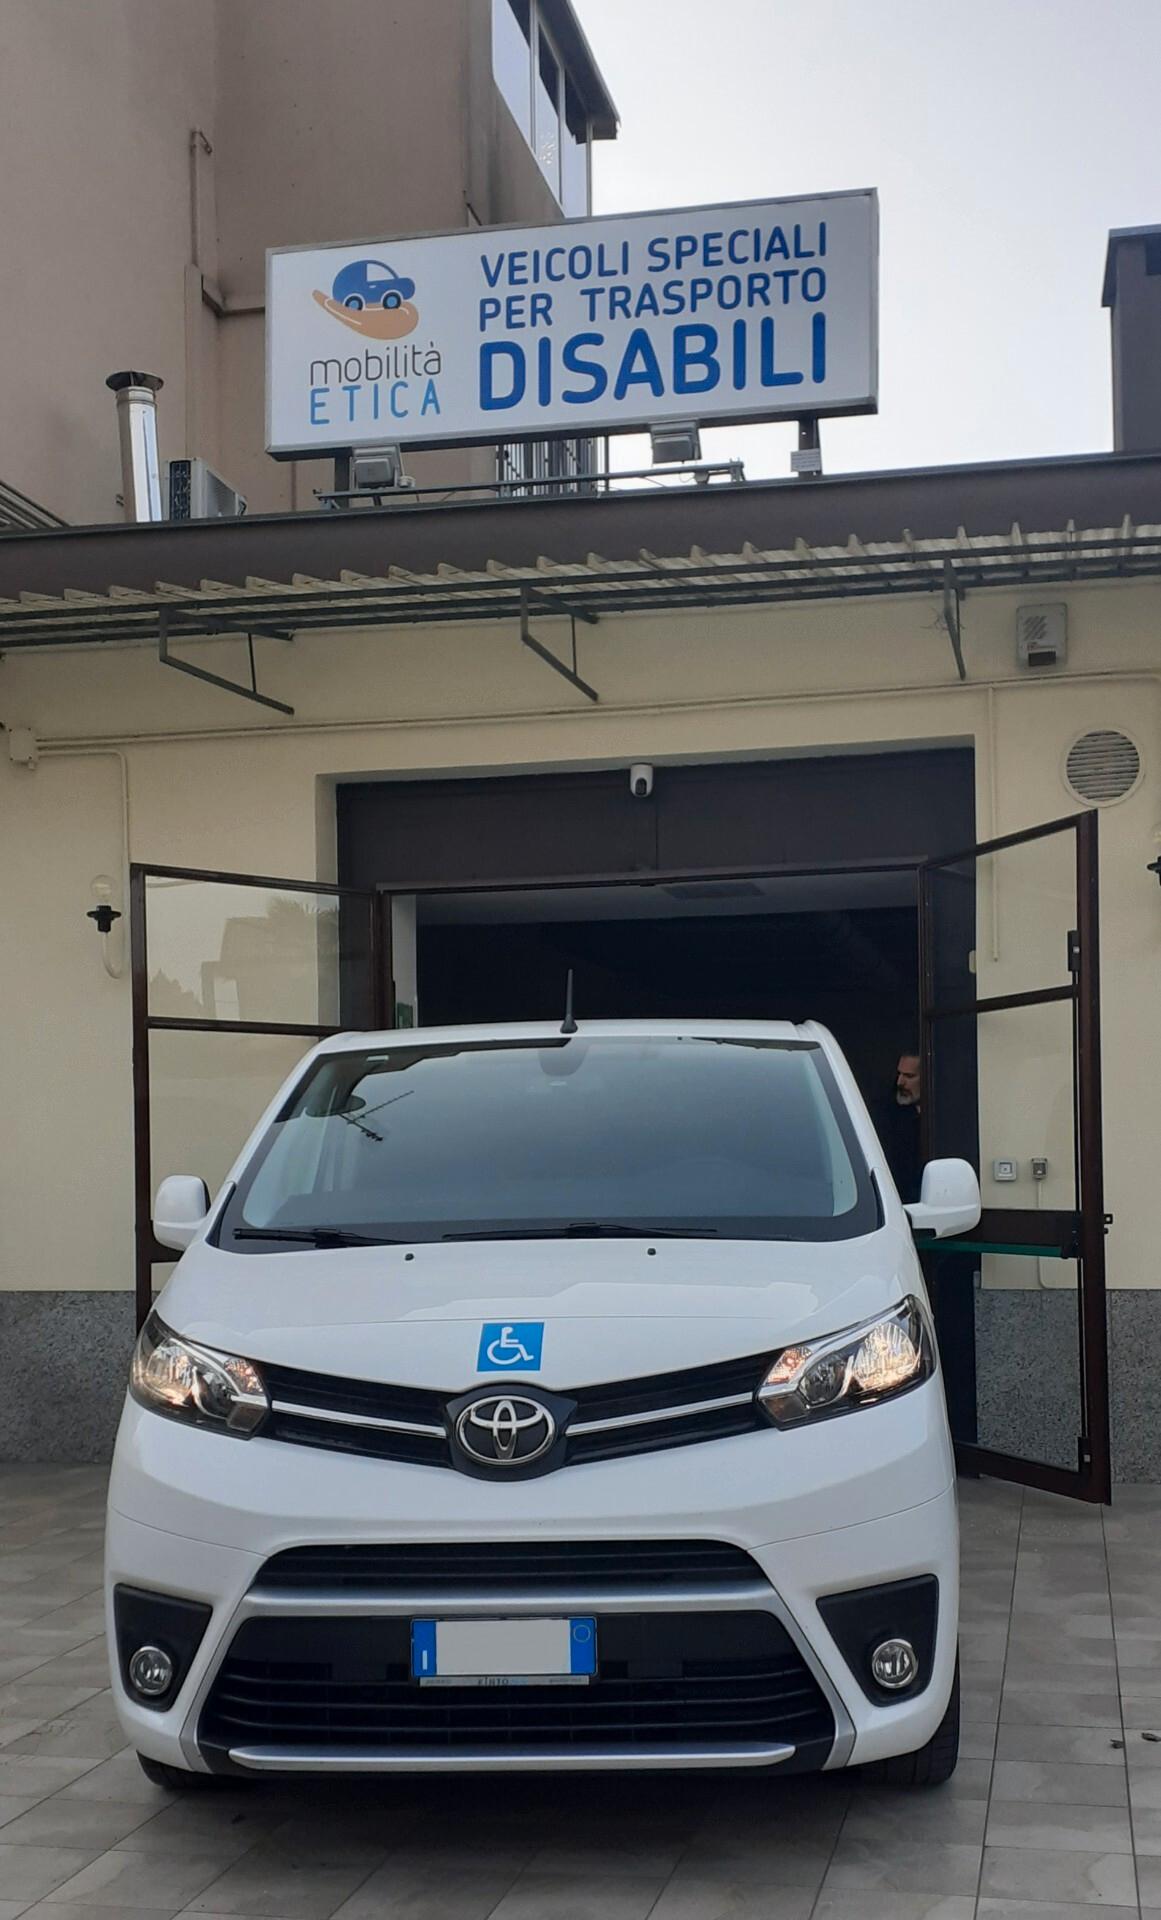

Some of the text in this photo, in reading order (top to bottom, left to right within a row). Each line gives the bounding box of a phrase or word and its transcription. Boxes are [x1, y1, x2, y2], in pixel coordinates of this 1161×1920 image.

[480, 221, 828, 288] VEICOLI SPECIALI
[479, 266, 828, 332] PER TRASPORTO
[310, 340, 442, 387] mobilità
[479, 311, 828, 411] DISABILI
[308, 378, 442, 428] ETICA
